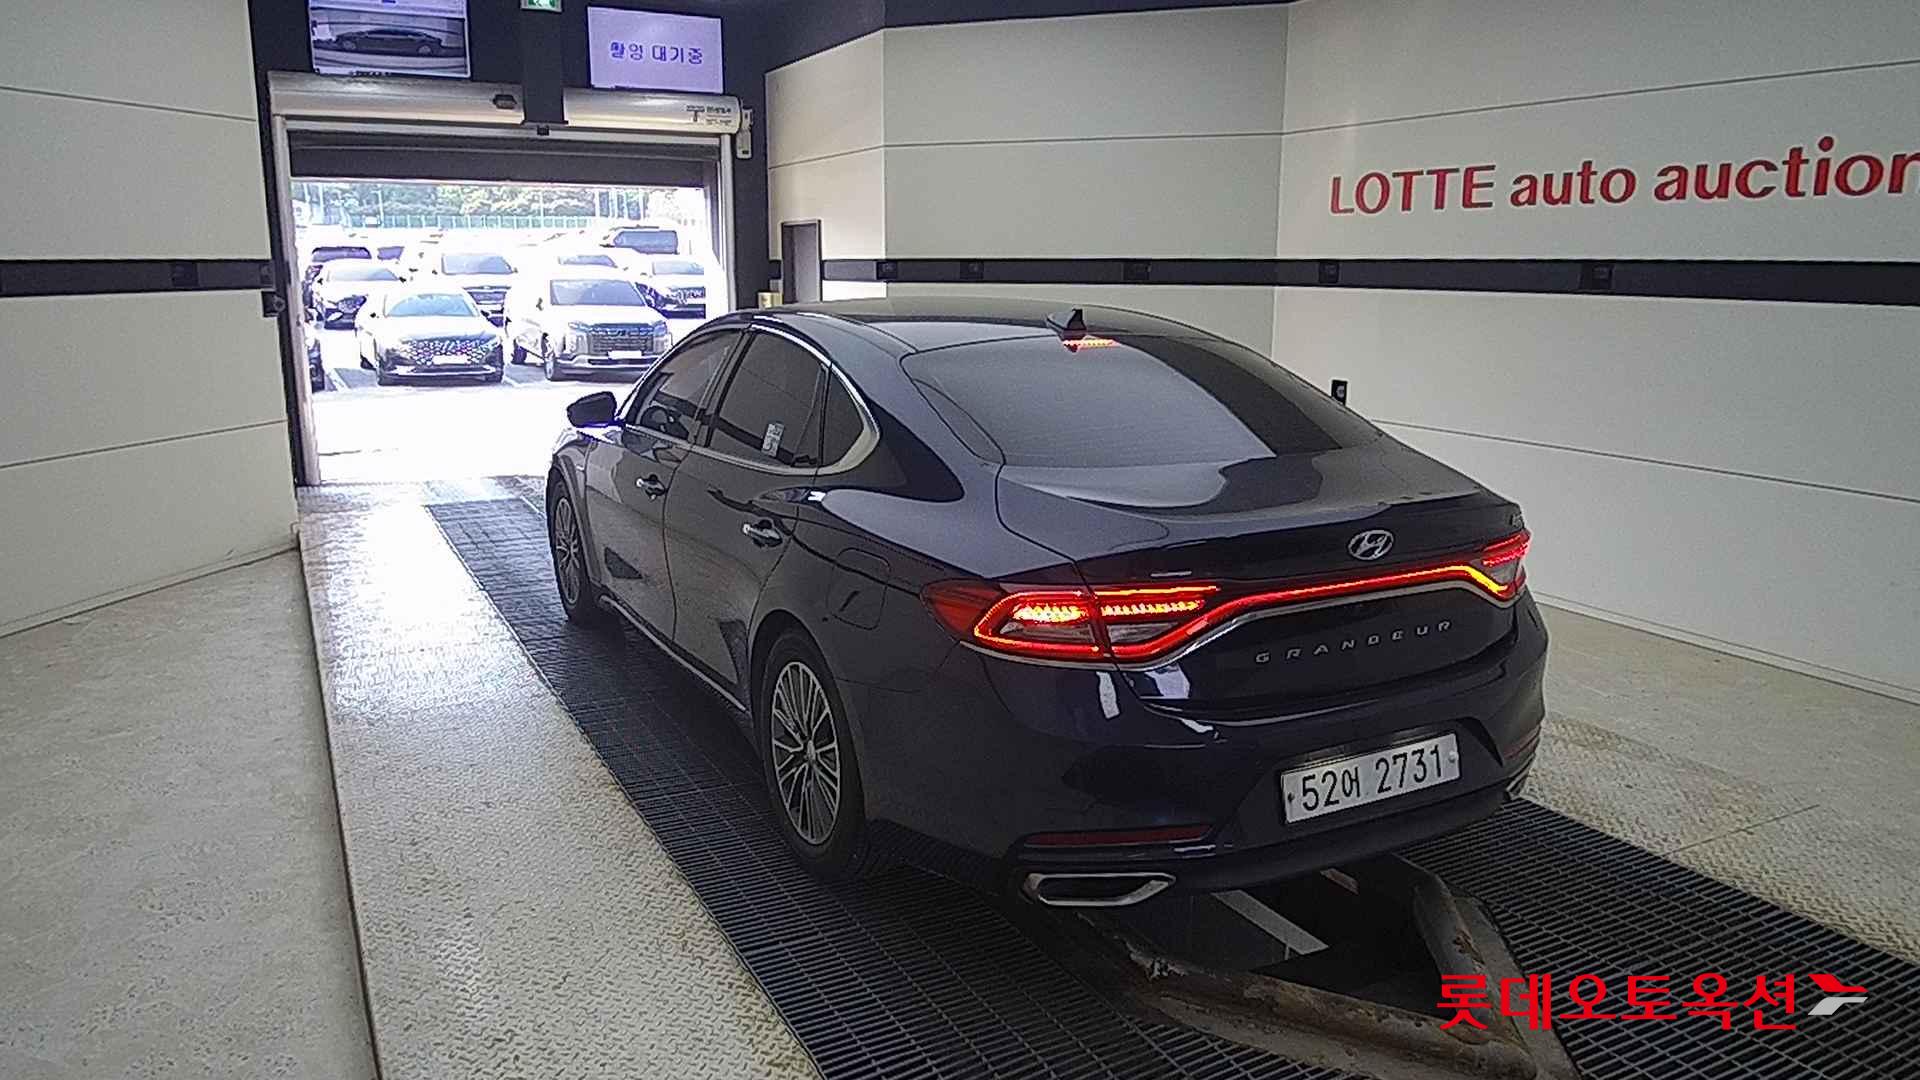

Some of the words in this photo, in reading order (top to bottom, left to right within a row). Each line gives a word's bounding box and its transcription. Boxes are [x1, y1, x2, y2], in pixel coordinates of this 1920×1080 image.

[652, 45, 703, 65] 대기중
[1330, 164, 1496, 214] LOTTE
[1510, 160, 1636, 206] auto
[1255, 620, 1451, 664] GRANDEUR
[1302, 767, 1361, 811] 52어
[1375, 744, 1442, 794] 2731
